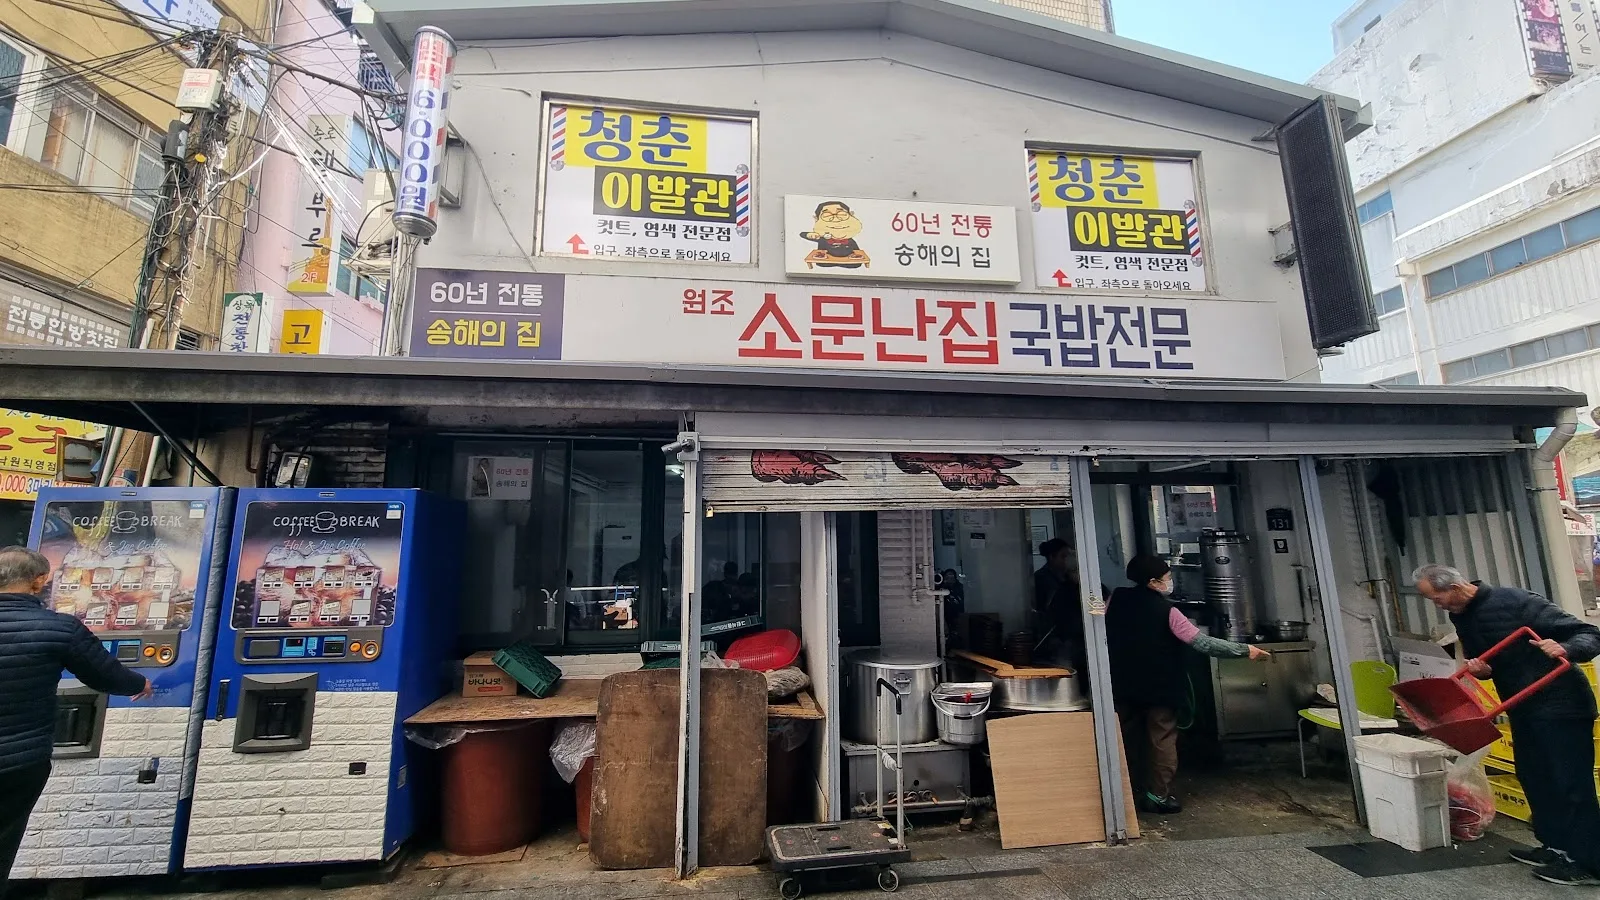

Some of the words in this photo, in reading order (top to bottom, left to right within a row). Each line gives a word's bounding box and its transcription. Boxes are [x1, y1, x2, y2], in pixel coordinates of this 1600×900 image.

[579, 109, 692, 168] 청춘
[1048, 154, 1145, 205] 청춘
[601, 170, 734, 219] 이발관
[644, 221, 678, 239] 염색
[681, 223, 732, 243] 전문점
[890, 211, 941, 237] 60년
[951, 212, 993, 240] 전통
[1074, 209, 1186, 252] 이발관
[624, 245, 672, 261] 좌측으로
[675, 247, 732, 263] 돌아오세요
[893, 243, 962, 268] 송해의
[971, 244, 992, 269] 집
[1113, 255, 1143, 272] 염색
[1146, 255, 1189, 273] 전문점
[301, 271, 319, 284] 2F
[1143, 278, 1192, 292] 돌아오세요
[430, 281, 488, 306] 60년
[497, 281, 544, 308] 전통
[285, 323, 312, 354] 고
[425, 318, 507, 348] 송해의
[515, 320, 542, 349] 집
[682, 287, 735, 316] 원조
[738, 291, 1000, 367] 소문난집
[1009, 301, 1195, 371] 국밥전문
[140, 515, 184, 528] BREAK
[339, 515, 381, 529] BREAK
[283, 539, 303, 551] Hot
[336, 537, 366, 551] Coffee
